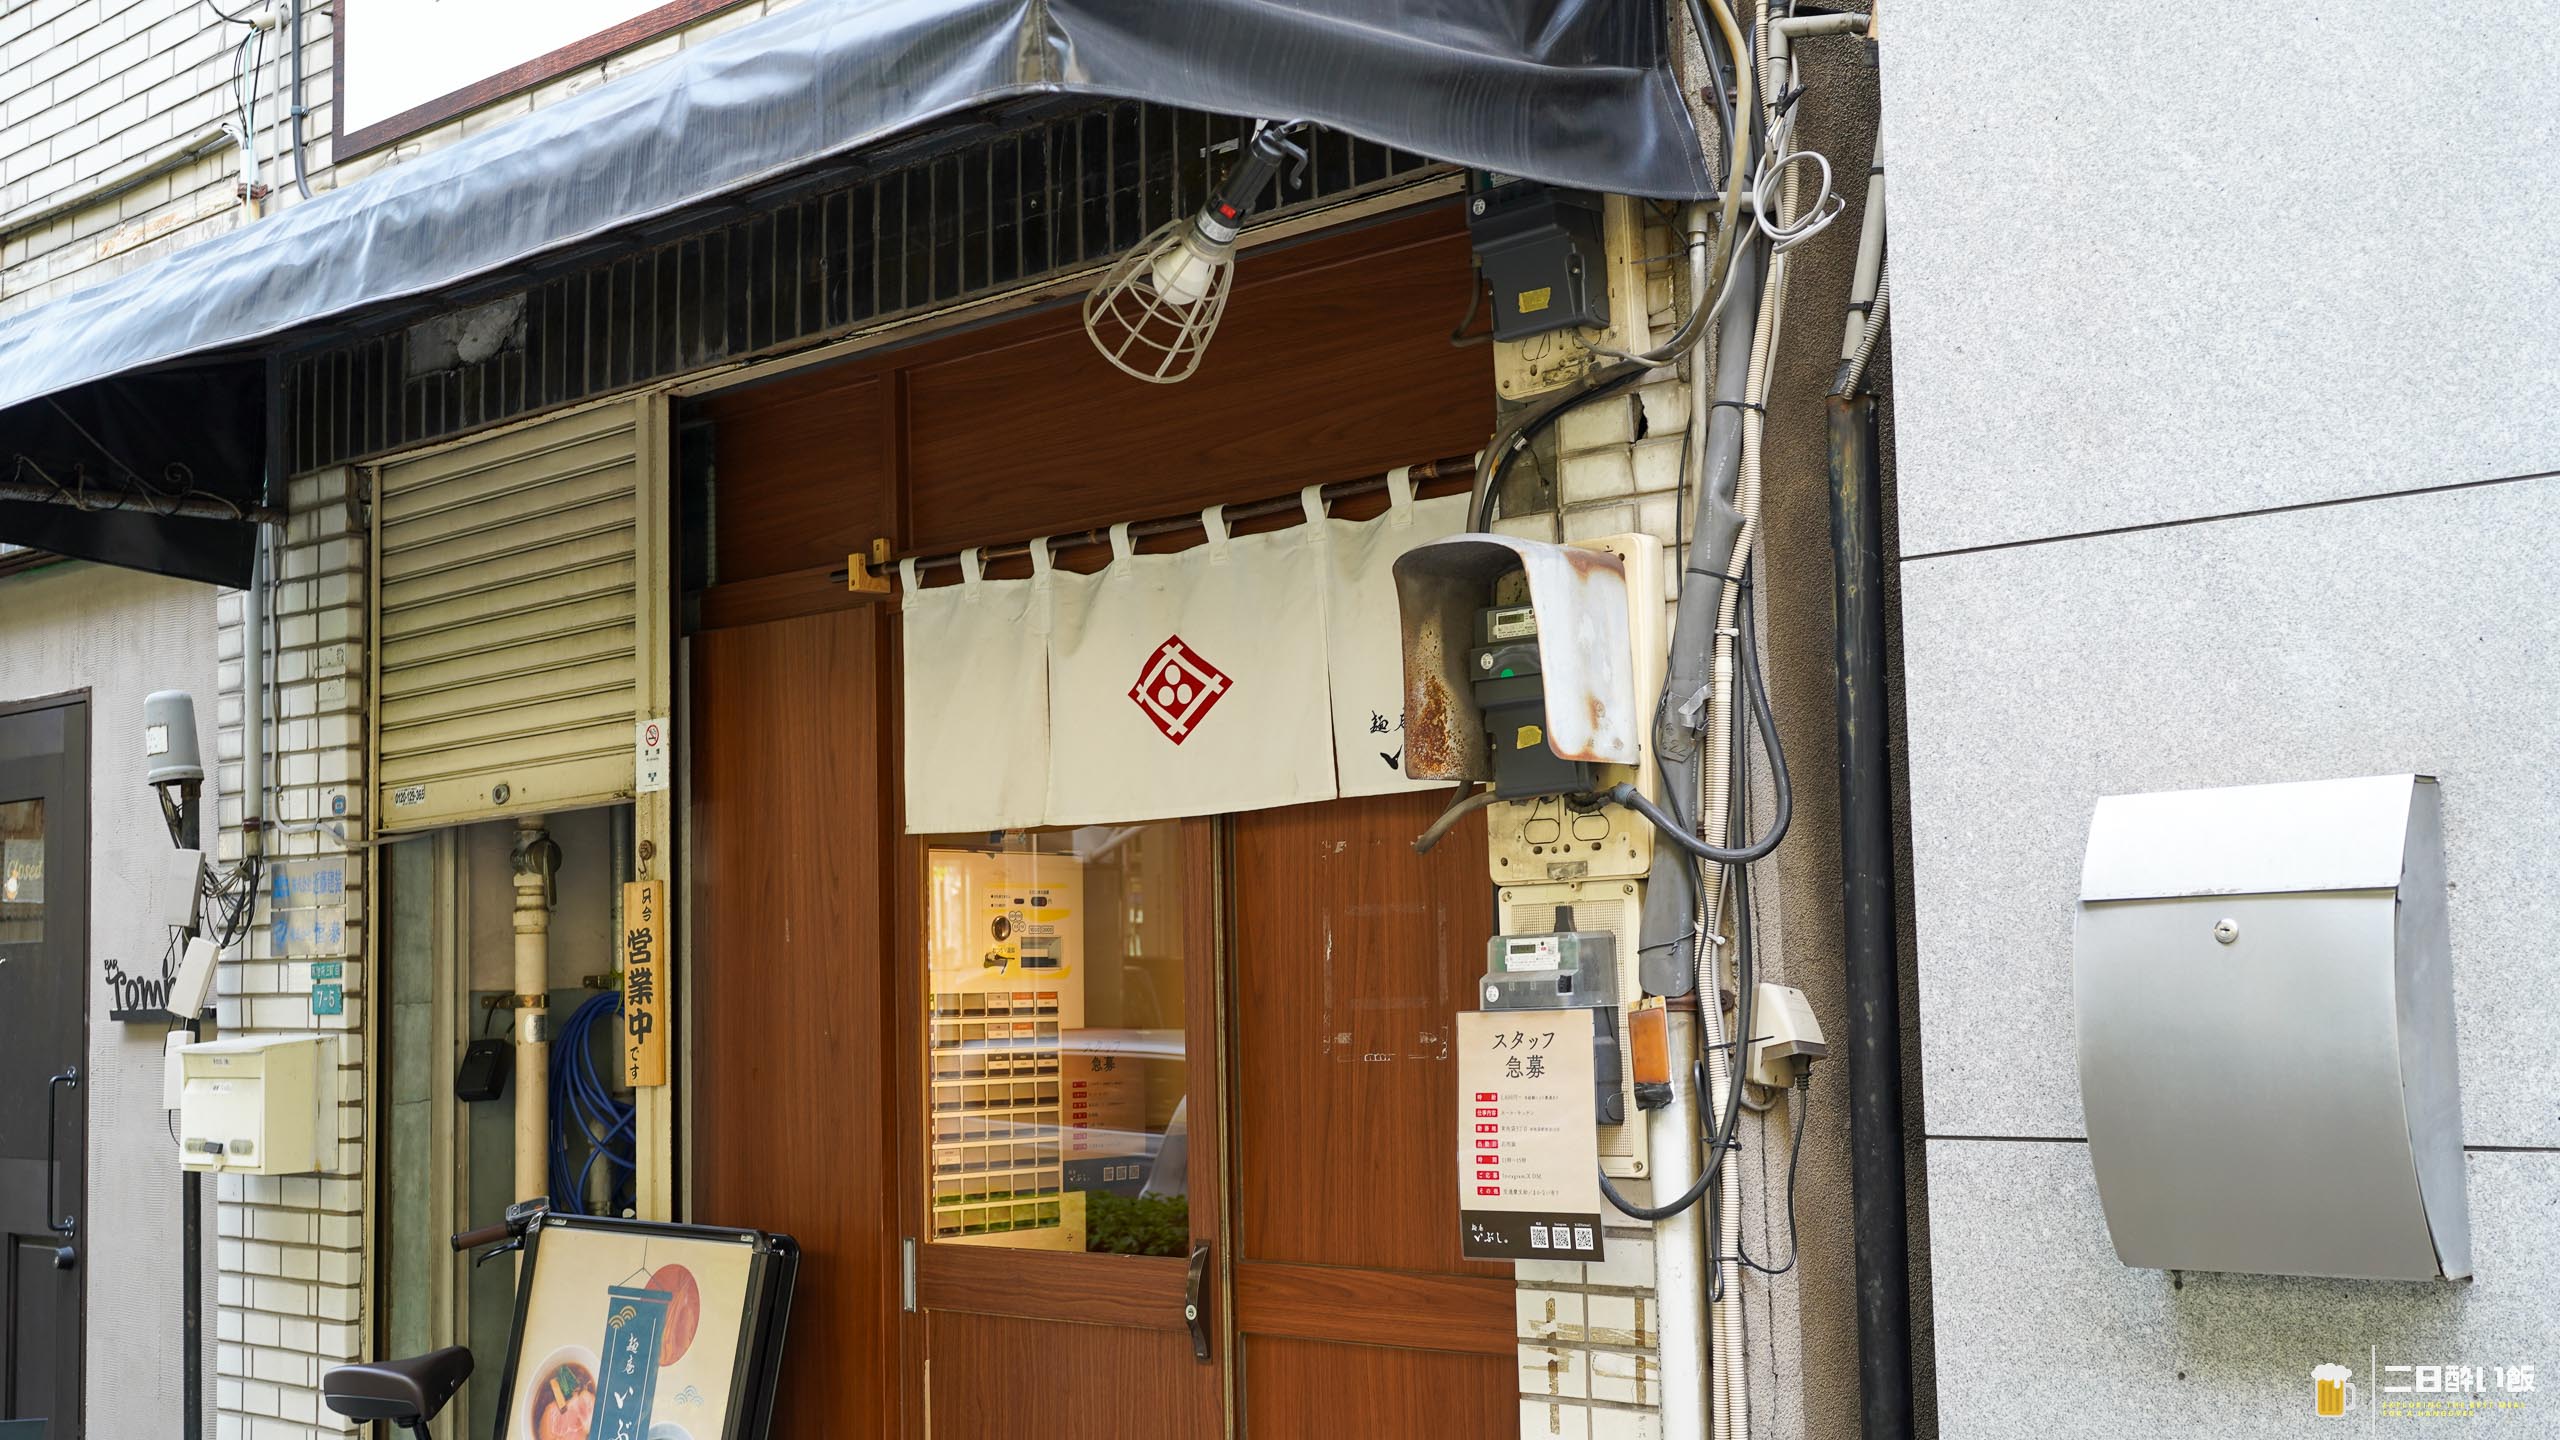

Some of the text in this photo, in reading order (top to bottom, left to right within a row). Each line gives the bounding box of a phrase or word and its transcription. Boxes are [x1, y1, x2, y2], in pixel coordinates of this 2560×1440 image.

[7, 859, 43, 880] Closed
[104, 959, 119, 972] BAR
[317, 990, 335, 1008] 7-5
[1492, 1031, 1555, 1050] スタッフ
[1091, 1056, 1116, 1073] 急募
[1505, 1055, 1545, 1079] 急募
[1479, 1187, 1499, 1195] その他
